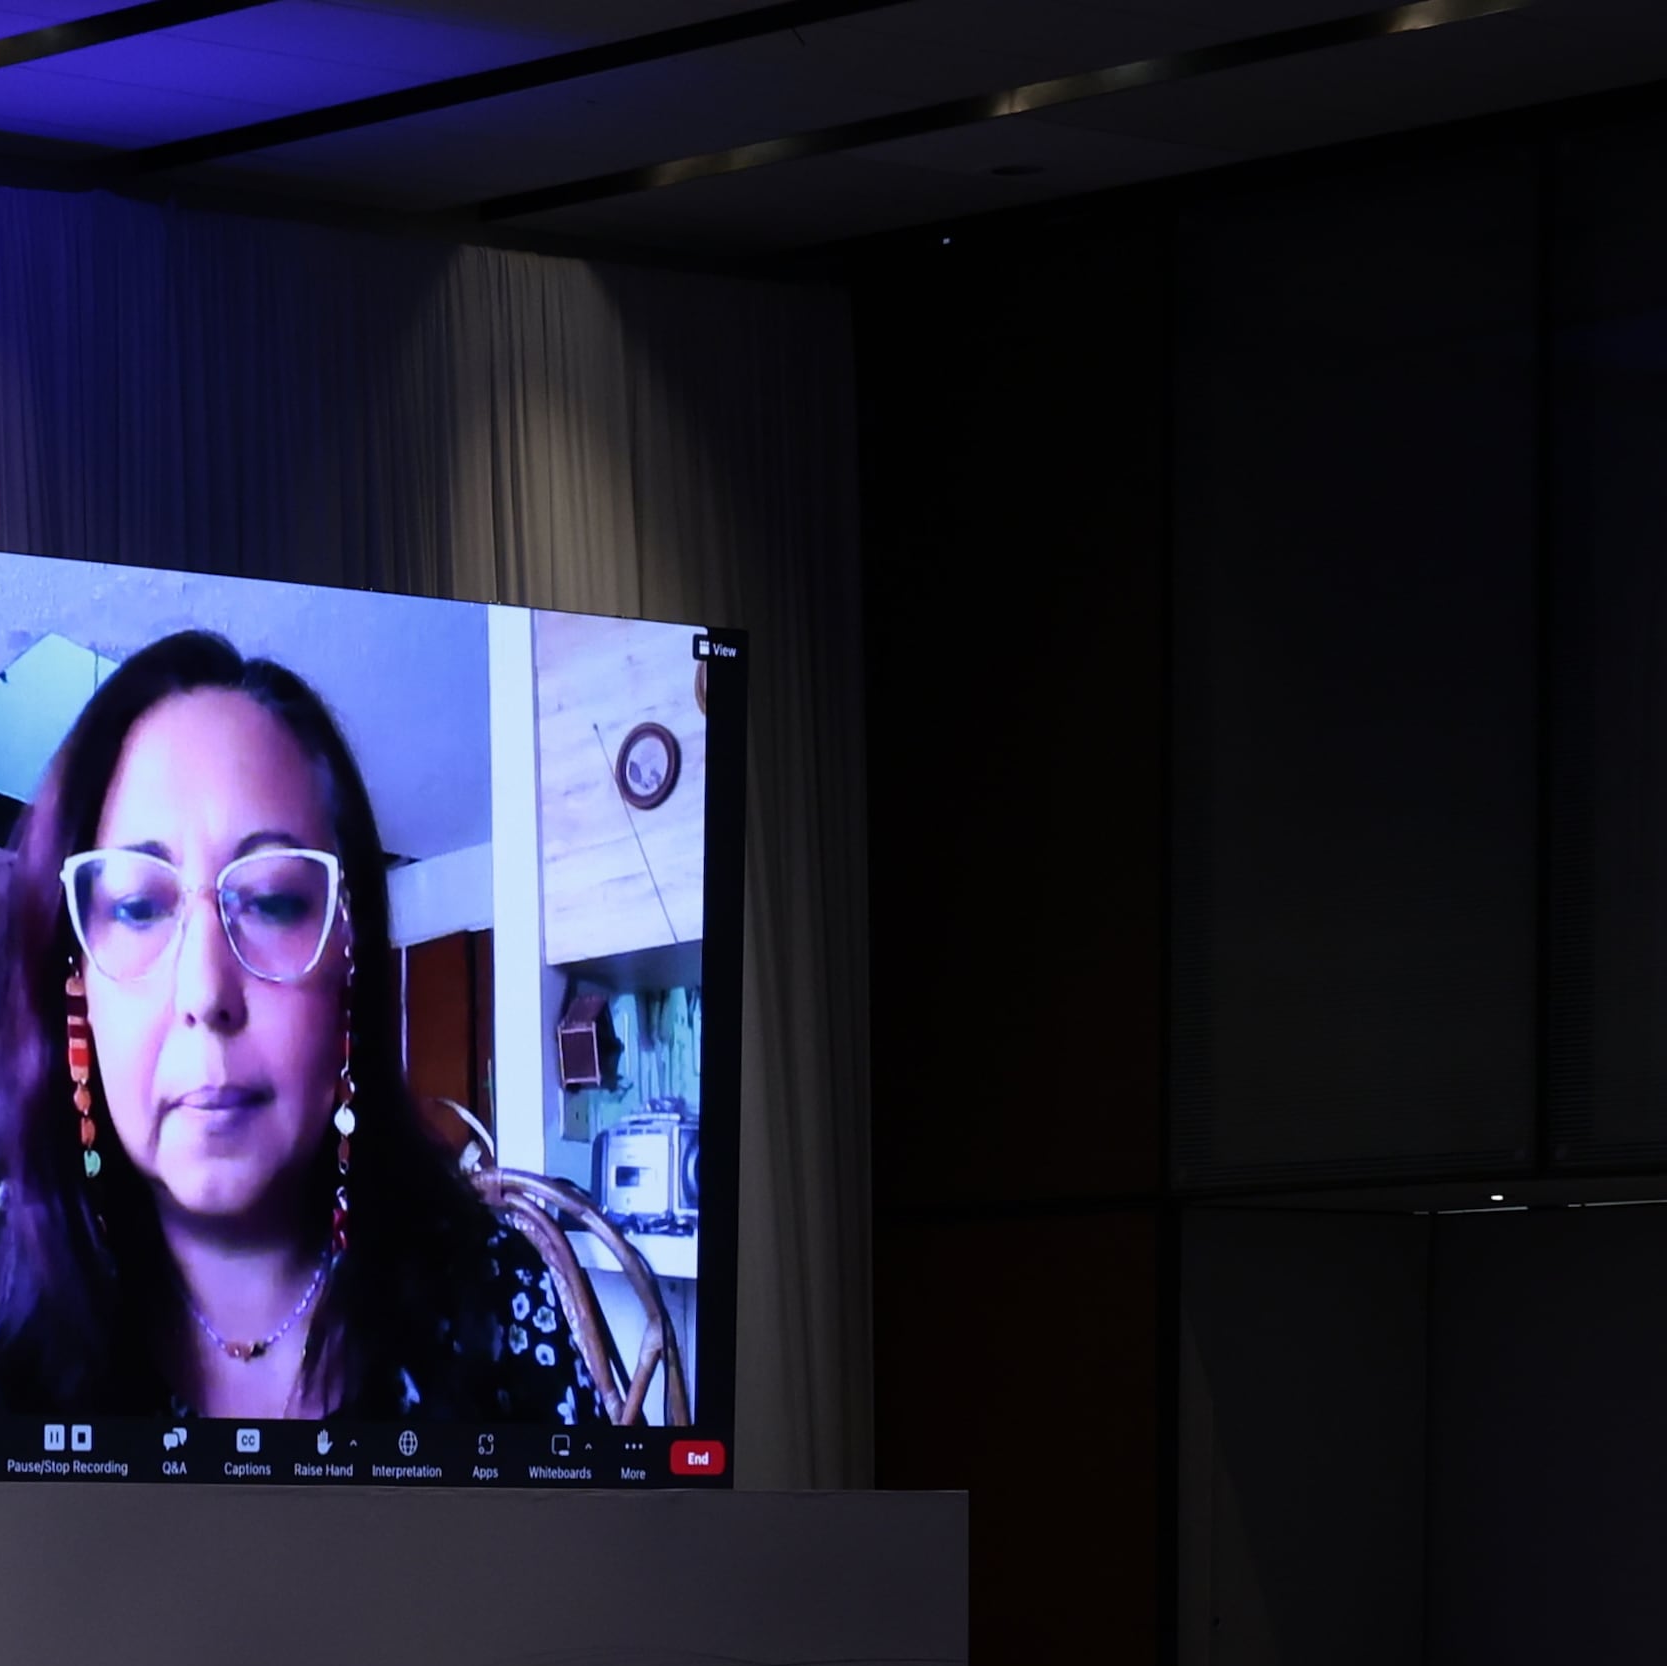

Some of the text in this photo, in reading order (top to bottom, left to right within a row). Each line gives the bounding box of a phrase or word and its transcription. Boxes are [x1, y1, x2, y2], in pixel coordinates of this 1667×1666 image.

[712, 642, 737, 658] View
[687, 1452, 709, 1466] End
[7, 1459, 128, 1476] Pause/Stop Recording
[162, 1461, 187, 1475] Q&A
[224, 1462, 272, 1477] Captions
[294, 1463, 354, 1477] Raise Hand
[372, 1463, 442, 1479] Interpretation
[472, 1466, 499, 1480] Apps
[528, 1466, 592, 1480] Whiteboards
[620, 1466, 646, 1480] More
